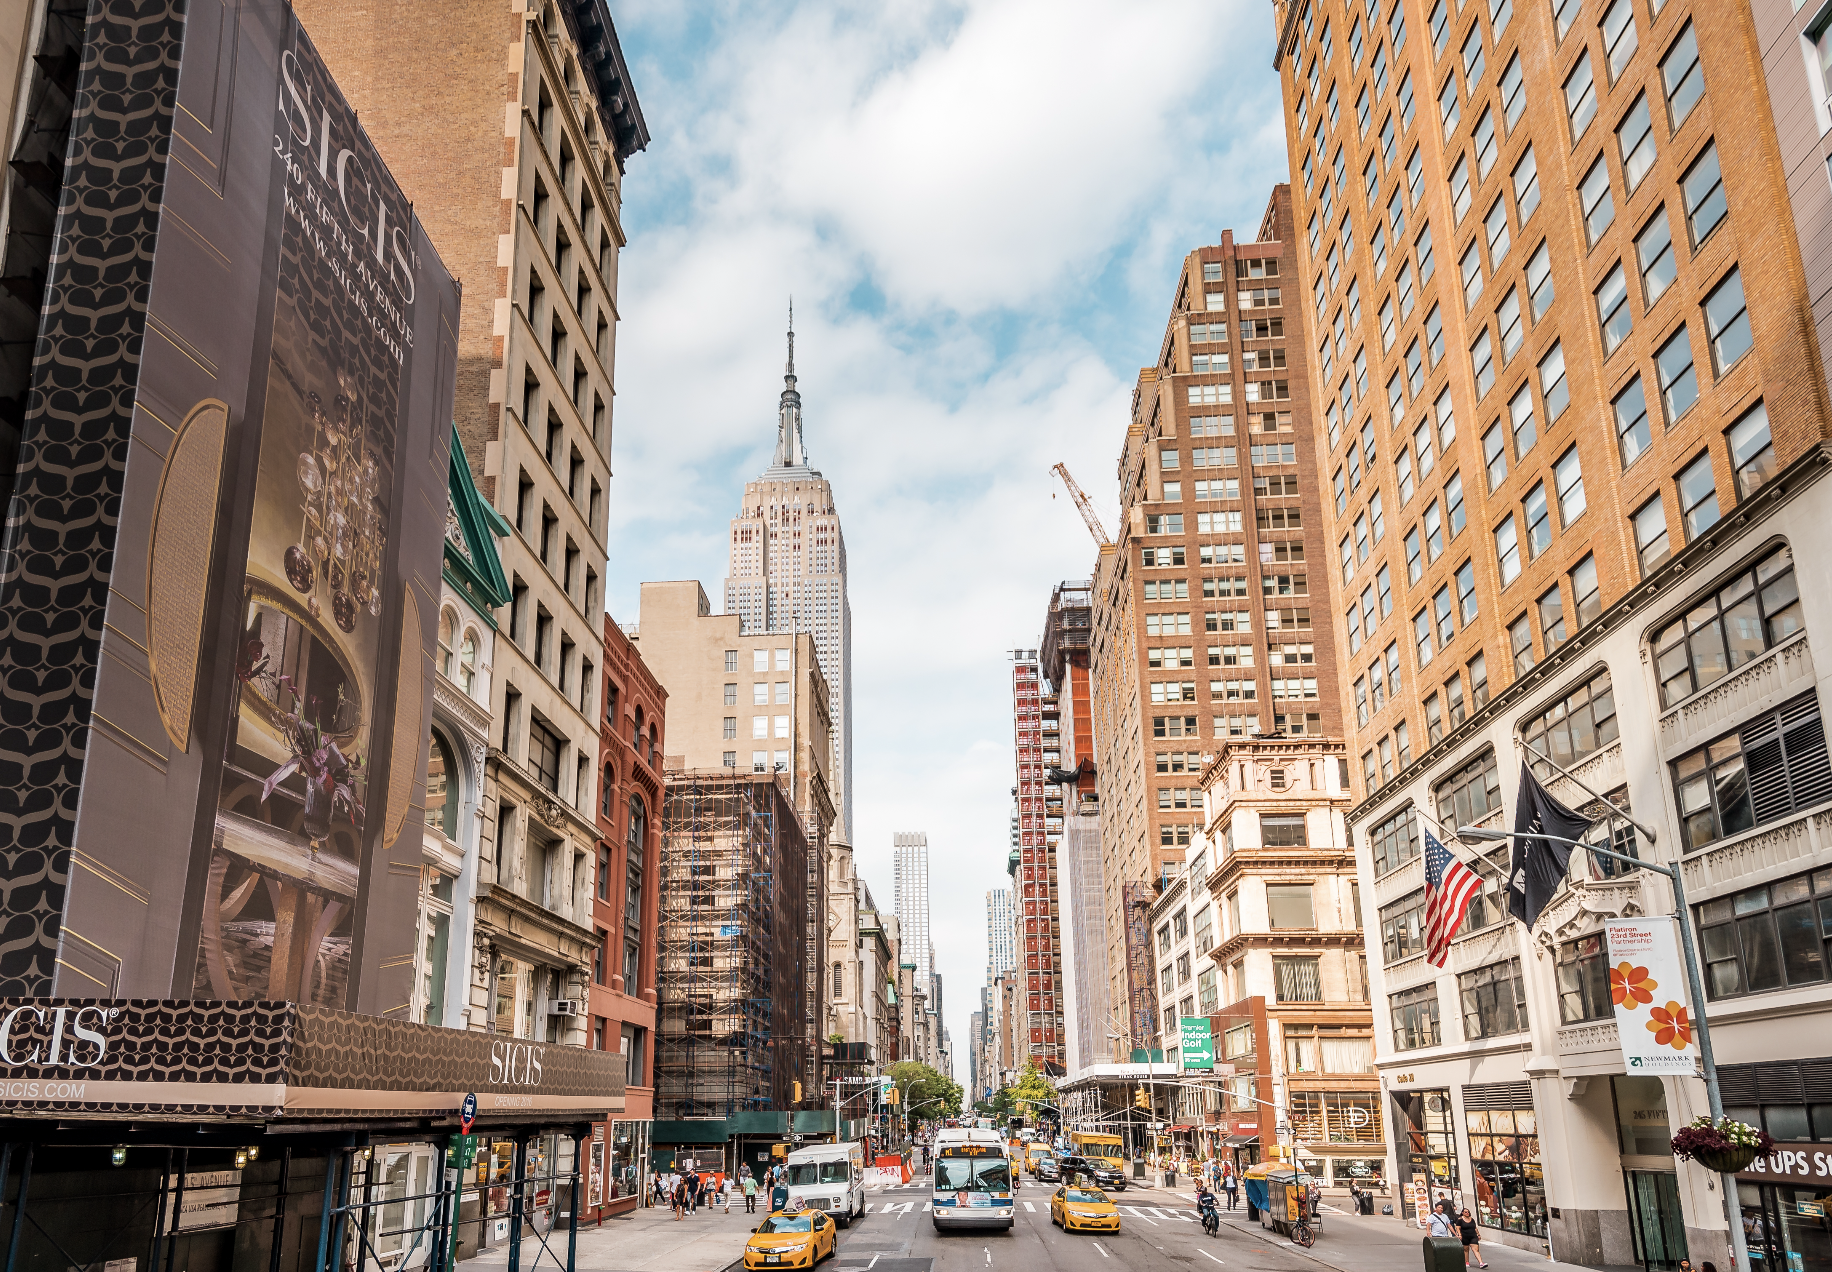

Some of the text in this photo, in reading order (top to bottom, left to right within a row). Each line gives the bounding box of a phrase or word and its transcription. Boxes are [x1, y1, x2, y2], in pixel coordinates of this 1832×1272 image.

[278, 50, 416, 305] SICIS
[273, 134, 414, 349] 240 FIFTH AVENUE
[1182, 1031, 1211, 1039] Indoor
[1182, 1039, 1202, 1047] Golf
[489, 1040, 543, 1086] SICIS
[1769, 1150, 1810, 1176] UPS
